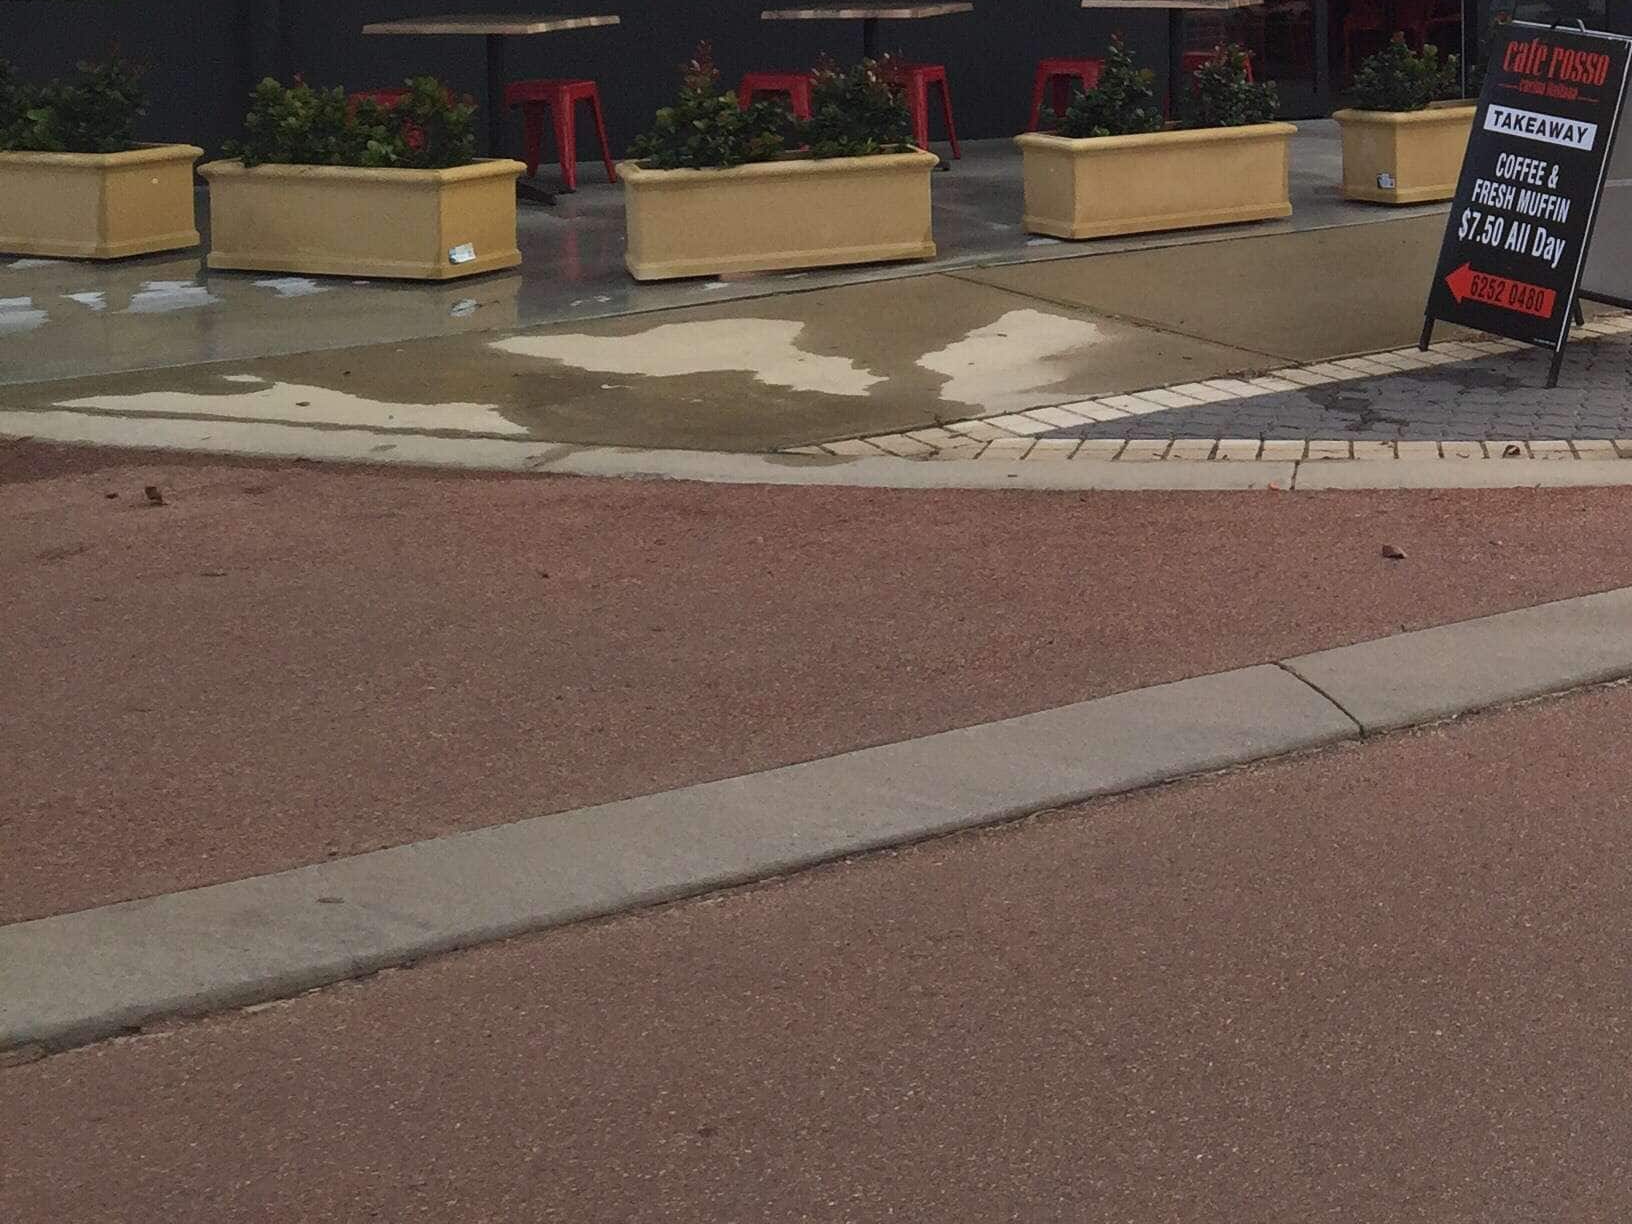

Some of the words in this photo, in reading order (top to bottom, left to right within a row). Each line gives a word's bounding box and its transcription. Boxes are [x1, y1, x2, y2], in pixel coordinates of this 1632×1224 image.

[1548, 44, 1611, 86] rosso
[1494, 109, 1590, 144] TAKEAWAY
[1496, 152, 1547, 187] COFFEE
[1547, 163, 1560, 188] &
[1472, 178, 1516, 209] FRESH
[1518, 189, 1571, 224] MUFFIN
[1458, 208, 1503, 243] $7.50
[1504, 219, 1529, 252] All
[1532, 225, 1566, 269] Day
[1469, 273, 1505, 304] 6252
[1507, 282, 1545, 312] 0480
